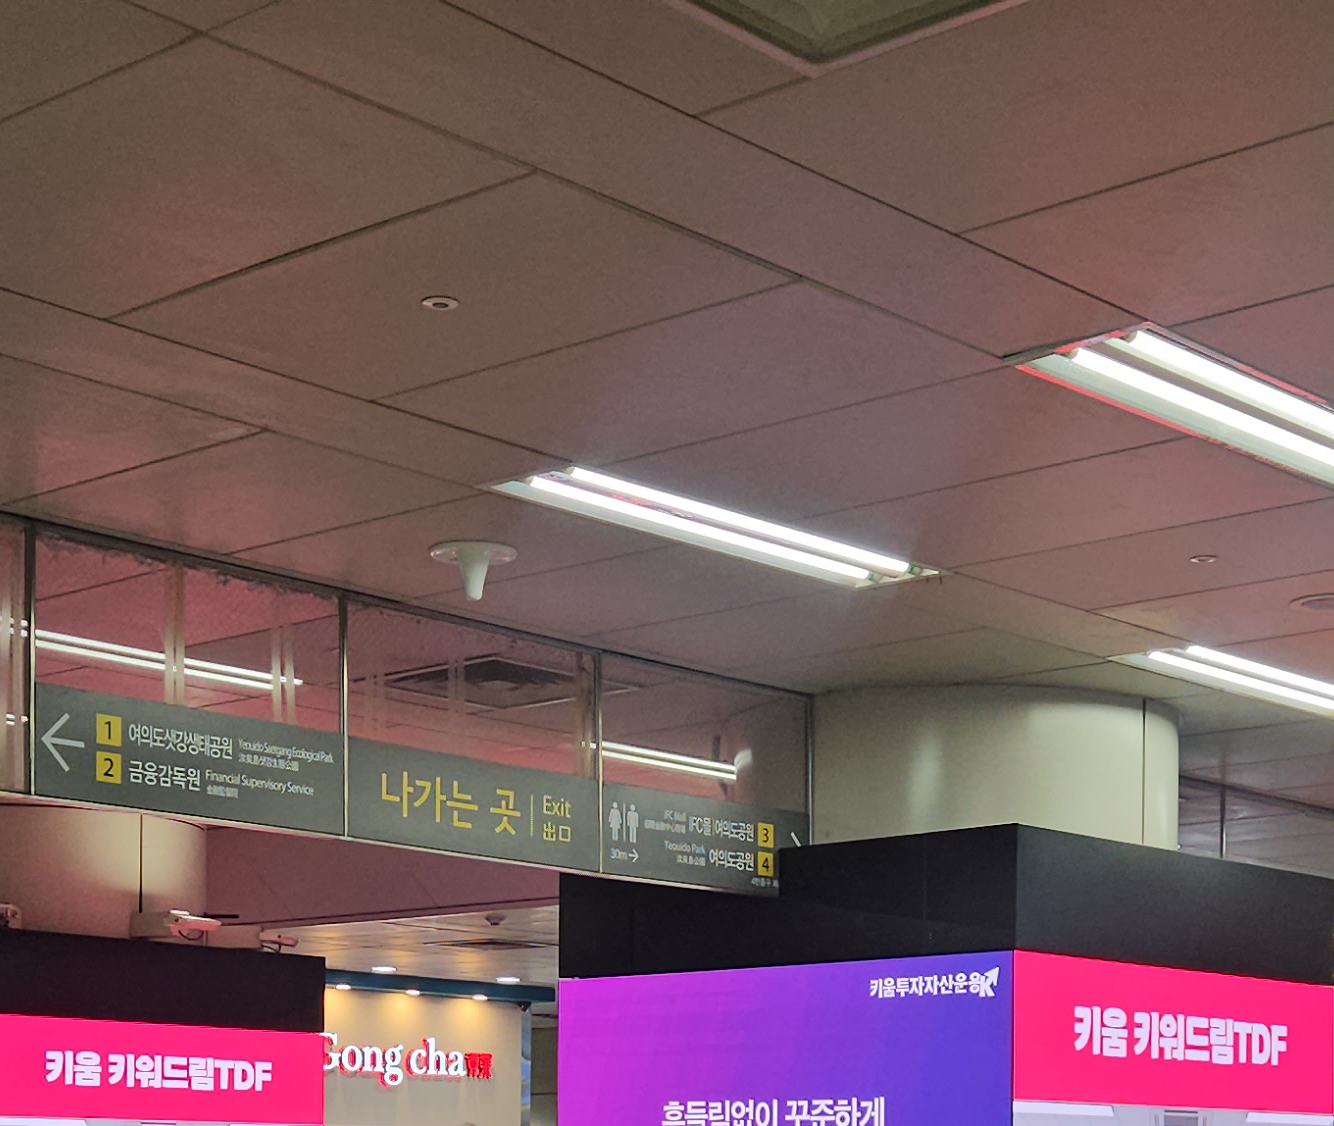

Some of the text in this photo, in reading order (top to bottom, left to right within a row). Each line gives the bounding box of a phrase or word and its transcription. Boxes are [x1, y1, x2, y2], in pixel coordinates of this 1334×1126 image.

[104, 721, 112, 740] 1
[128, 723, 233, 760] 여의도샛강생태공원
[103, 757, 114, 777] 2
[128, 760, 201, 791] 금융감독원
[205, 769, 241, 786] Financial
[287, 781, 315, 796] Service
[381, 771, 521, 836] 나가는 곳
[542, 794, 572, 818] Exit
[542, 821, 572, 843] 出口
[762, 828, 770, 843] 3
[708, 848, 755, 872] 여의도공원
[870, 971, 983, 998] 키움투자자산운용
[1074, 1005, 1289, 1066] 키움 키워드림TDF
[46, 1050, 273, 1091] 키움 키워드림TDF
[319, 1032, 466, 1086] Gong cha
